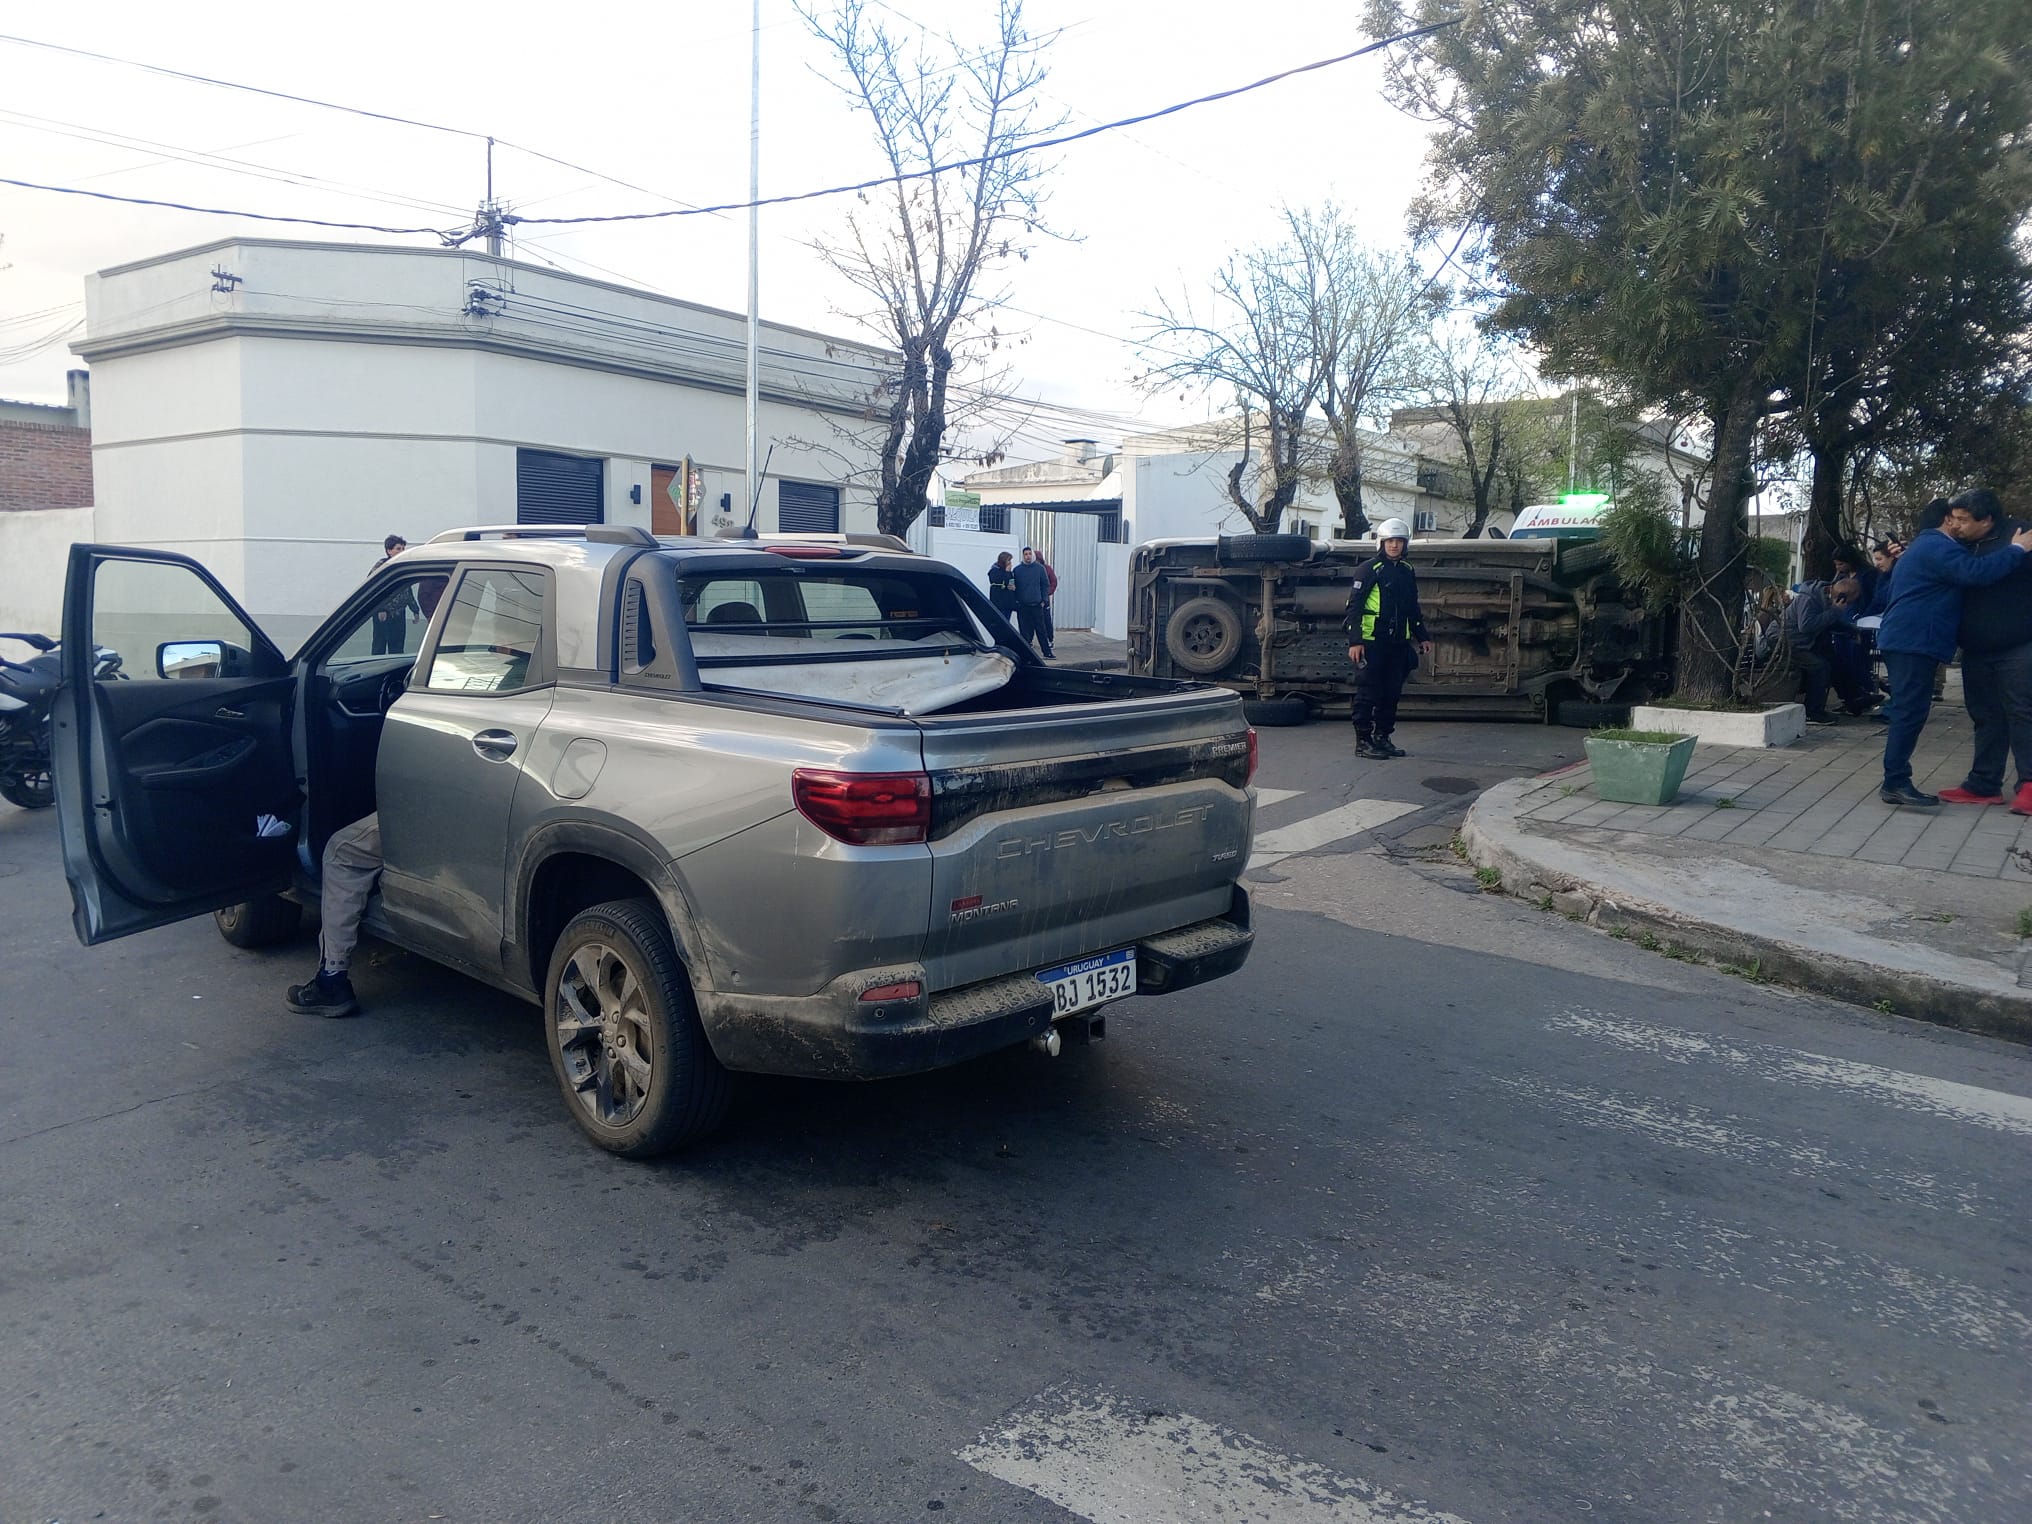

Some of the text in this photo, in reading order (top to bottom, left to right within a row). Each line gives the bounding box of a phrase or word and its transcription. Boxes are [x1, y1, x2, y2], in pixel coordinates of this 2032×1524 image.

[1527, 517, 1601, 527] AMBULAN
[1212, 741, 1248, 755] PREMIER
[997, 804, 1214, 860] CHEVROLET
[951, 899, 1018, 923] MONTANA
[1067, 958, 1104, 975] URUGUAY
[1053, 965, 1131, 1013] BJ 1532
